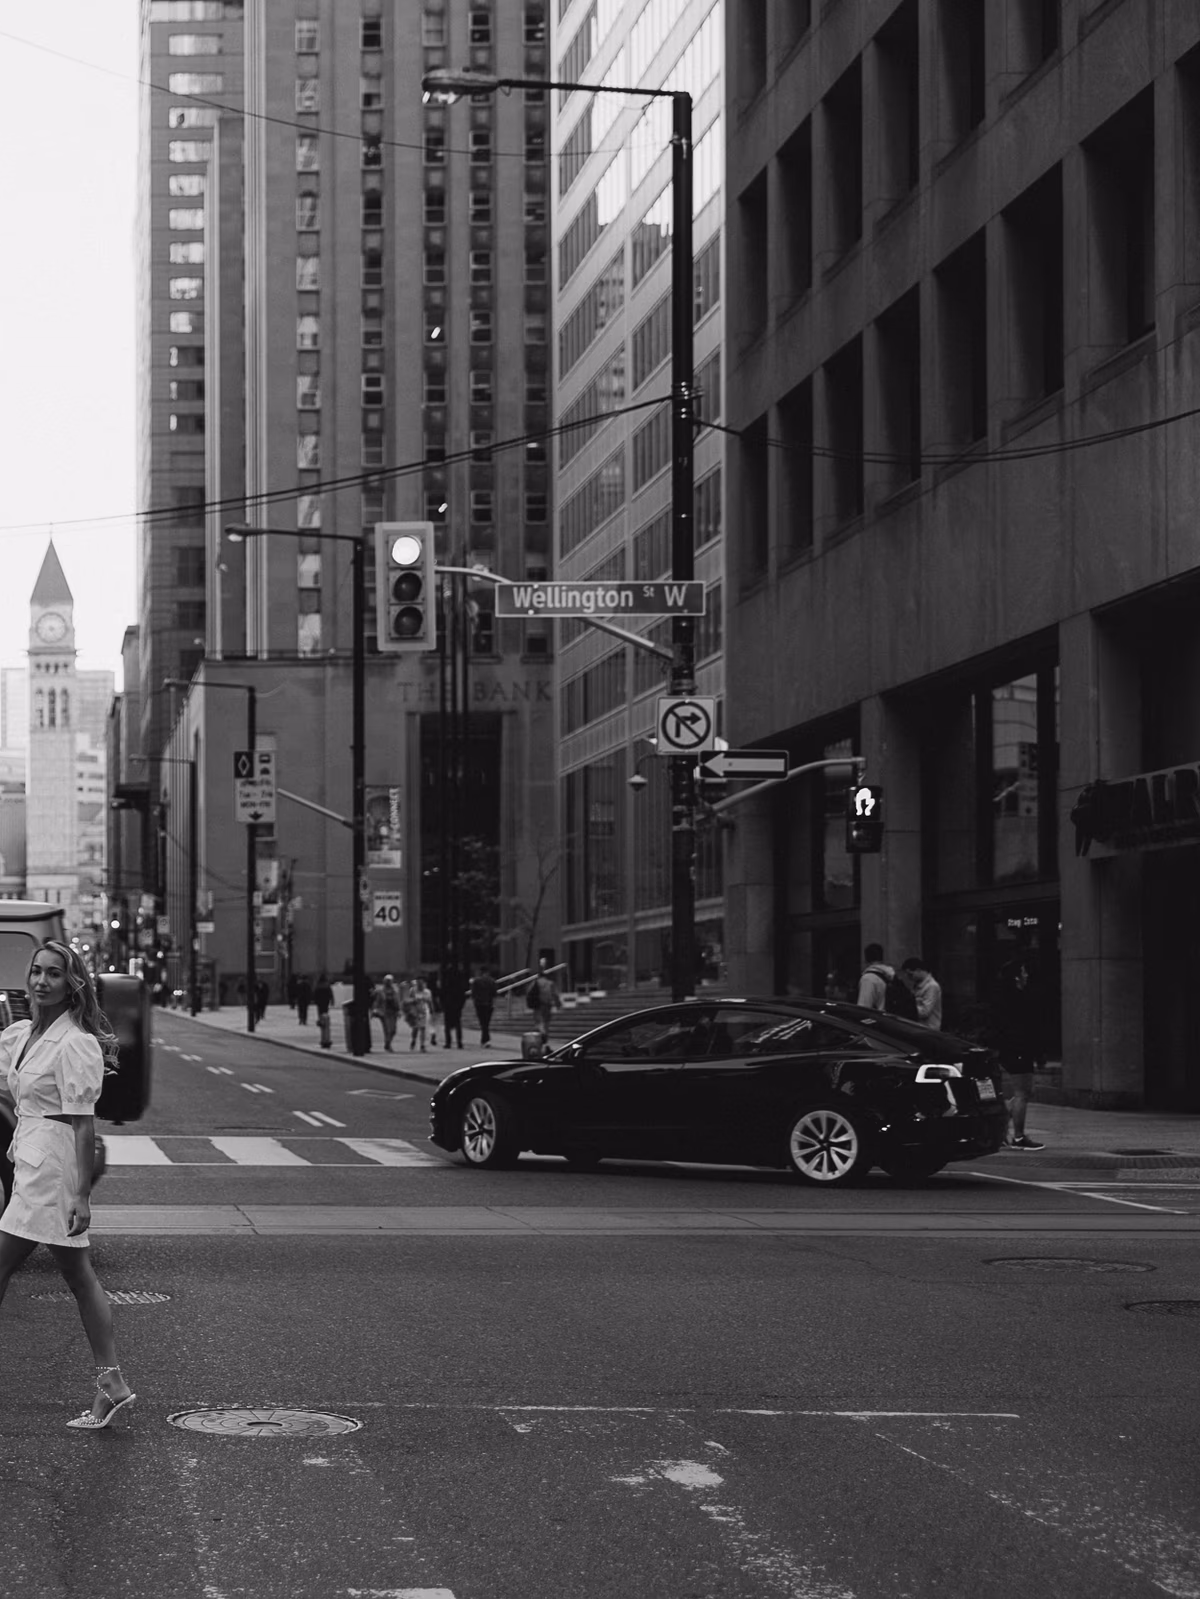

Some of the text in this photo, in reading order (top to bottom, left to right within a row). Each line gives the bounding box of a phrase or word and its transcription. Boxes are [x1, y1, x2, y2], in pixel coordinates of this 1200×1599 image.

[512, 585, 689, 613] Wellington St W
[473, 680, 552, 702] BANK
[374, 905, 401, 923] 40
